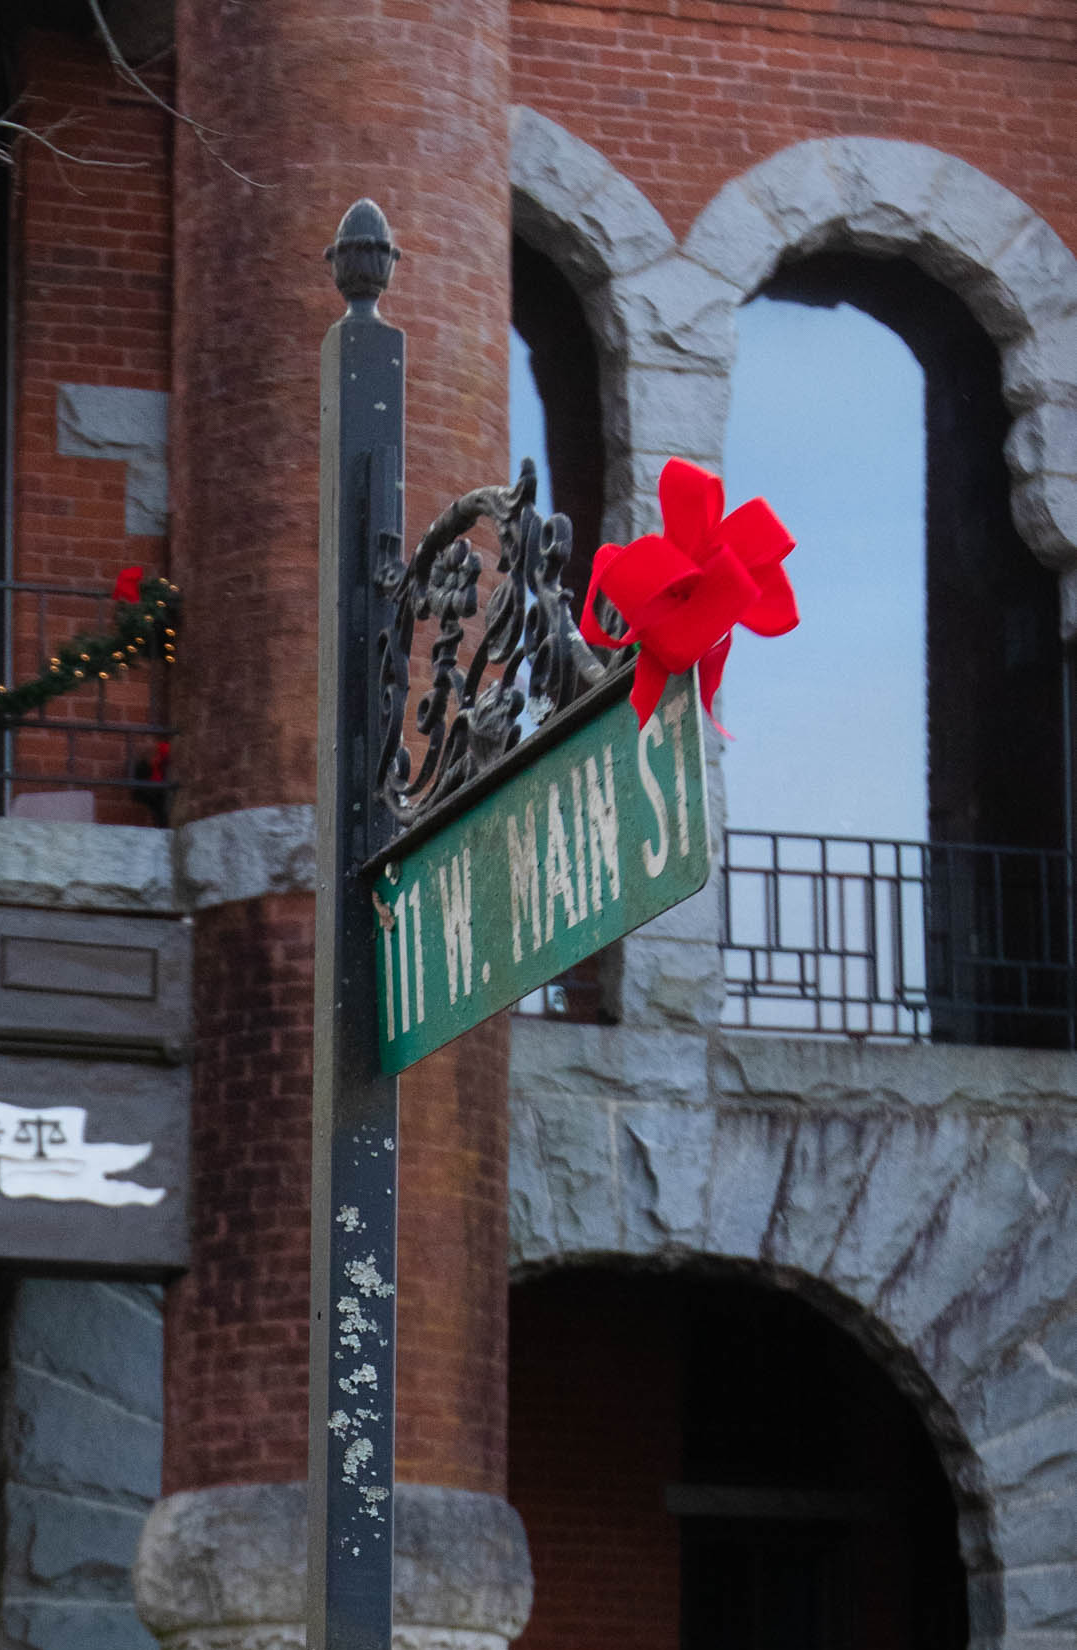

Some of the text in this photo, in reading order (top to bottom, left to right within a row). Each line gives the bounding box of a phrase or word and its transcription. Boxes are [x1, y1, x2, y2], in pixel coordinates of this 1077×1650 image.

[379, 692, 690, 1042] 111 W. MAIN ST
